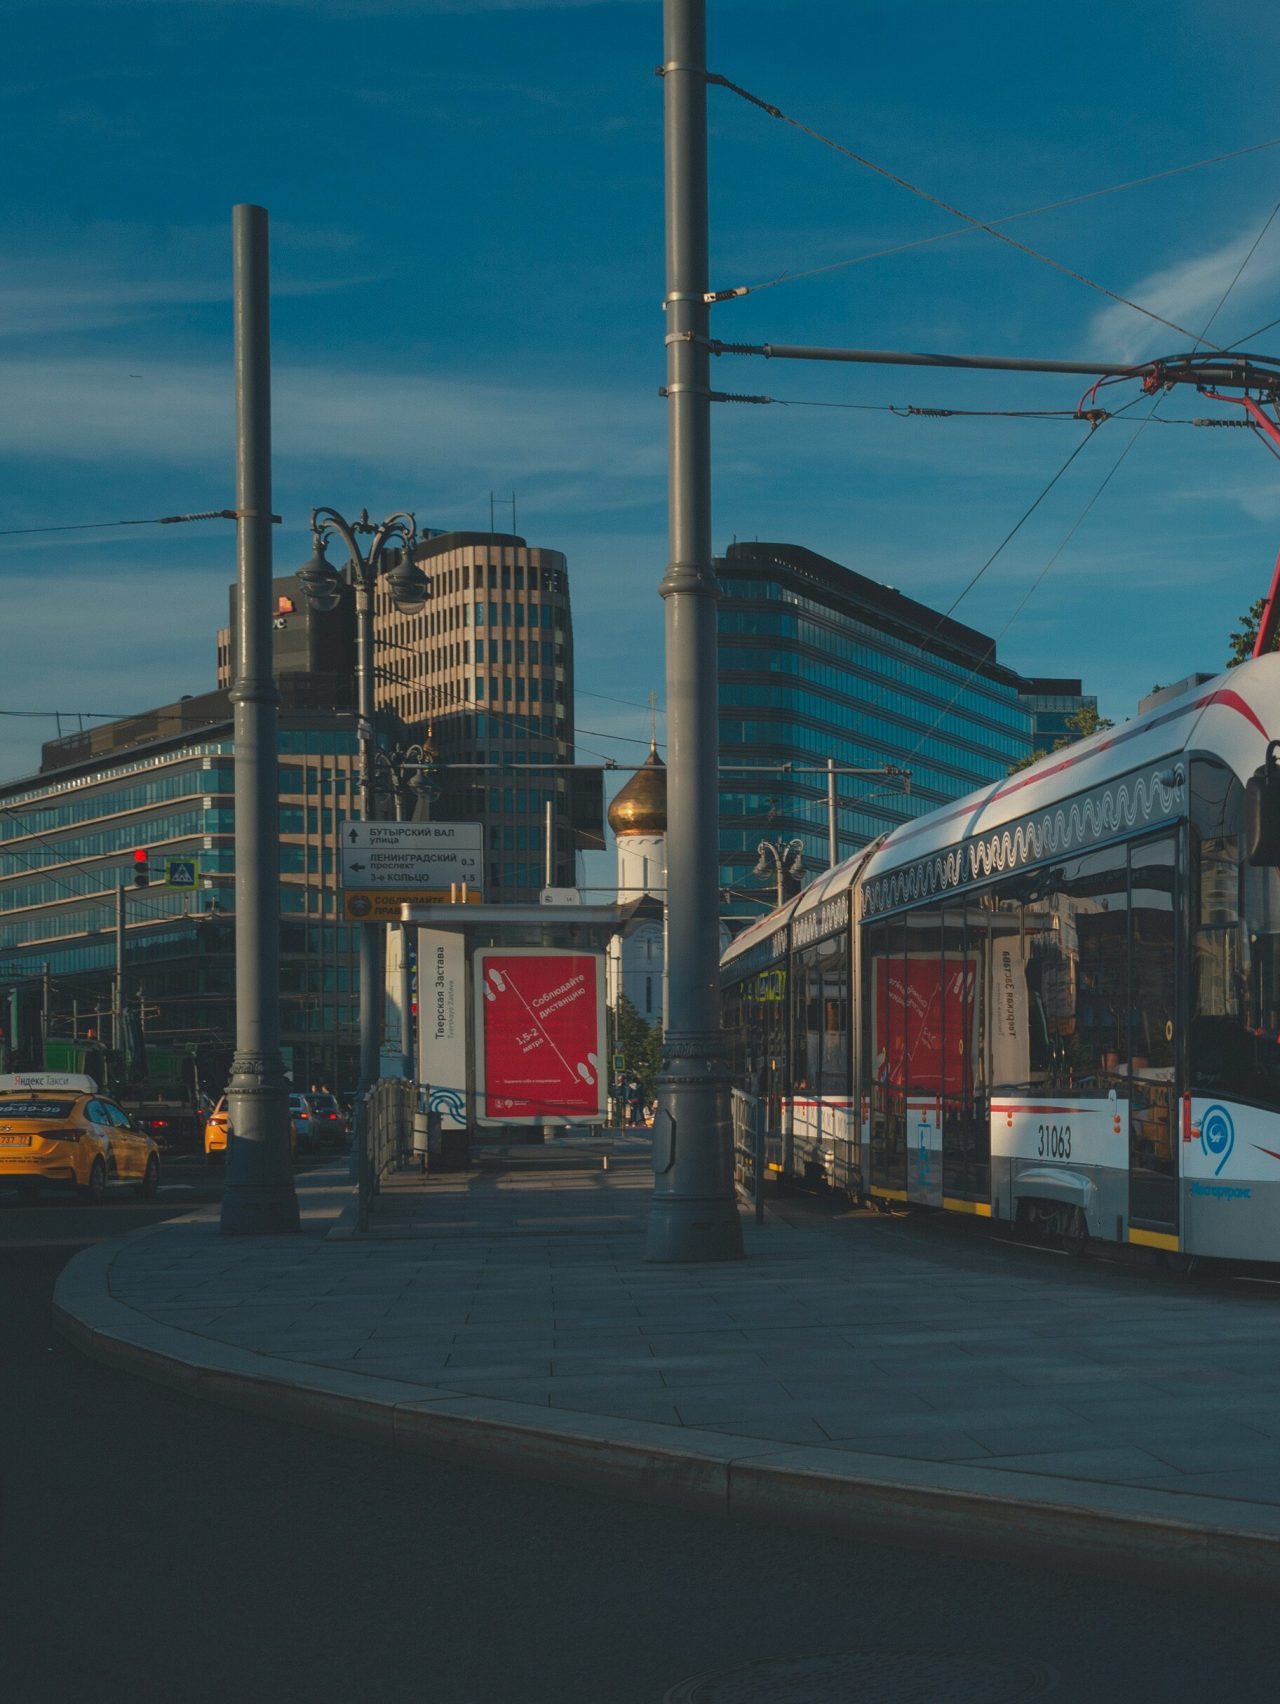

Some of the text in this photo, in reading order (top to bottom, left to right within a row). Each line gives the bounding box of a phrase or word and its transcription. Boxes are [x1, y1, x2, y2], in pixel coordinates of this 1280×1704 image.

[370, 827, 455, 837] БУТЫРСКИЙ ВАЛ
[370, 837, 399, 845] улица
[370, 853, 457, 862] ЛЕНИНГРАДСКИЙ
[461, 858, 475, 866] 0.3
[370, 862, 415, 871] проспект
[370, 873, 429, 882] 3-е КОЛЬЦО
[462, 874, 475, 882] 1.5
[435, 946, 446, 1040] Тверская Застава
[531, 974, 585, 1008] Соблюдайте
[538, 987, 586, 1019] дистанцию
[515, 1027, 540, 1046] 1,5-2
[522, 1038, 545, 1054] метра
[15, 1076, 69, 1087] Яндекс Такси
[1038, 1125, 1071, 1159] 31063
